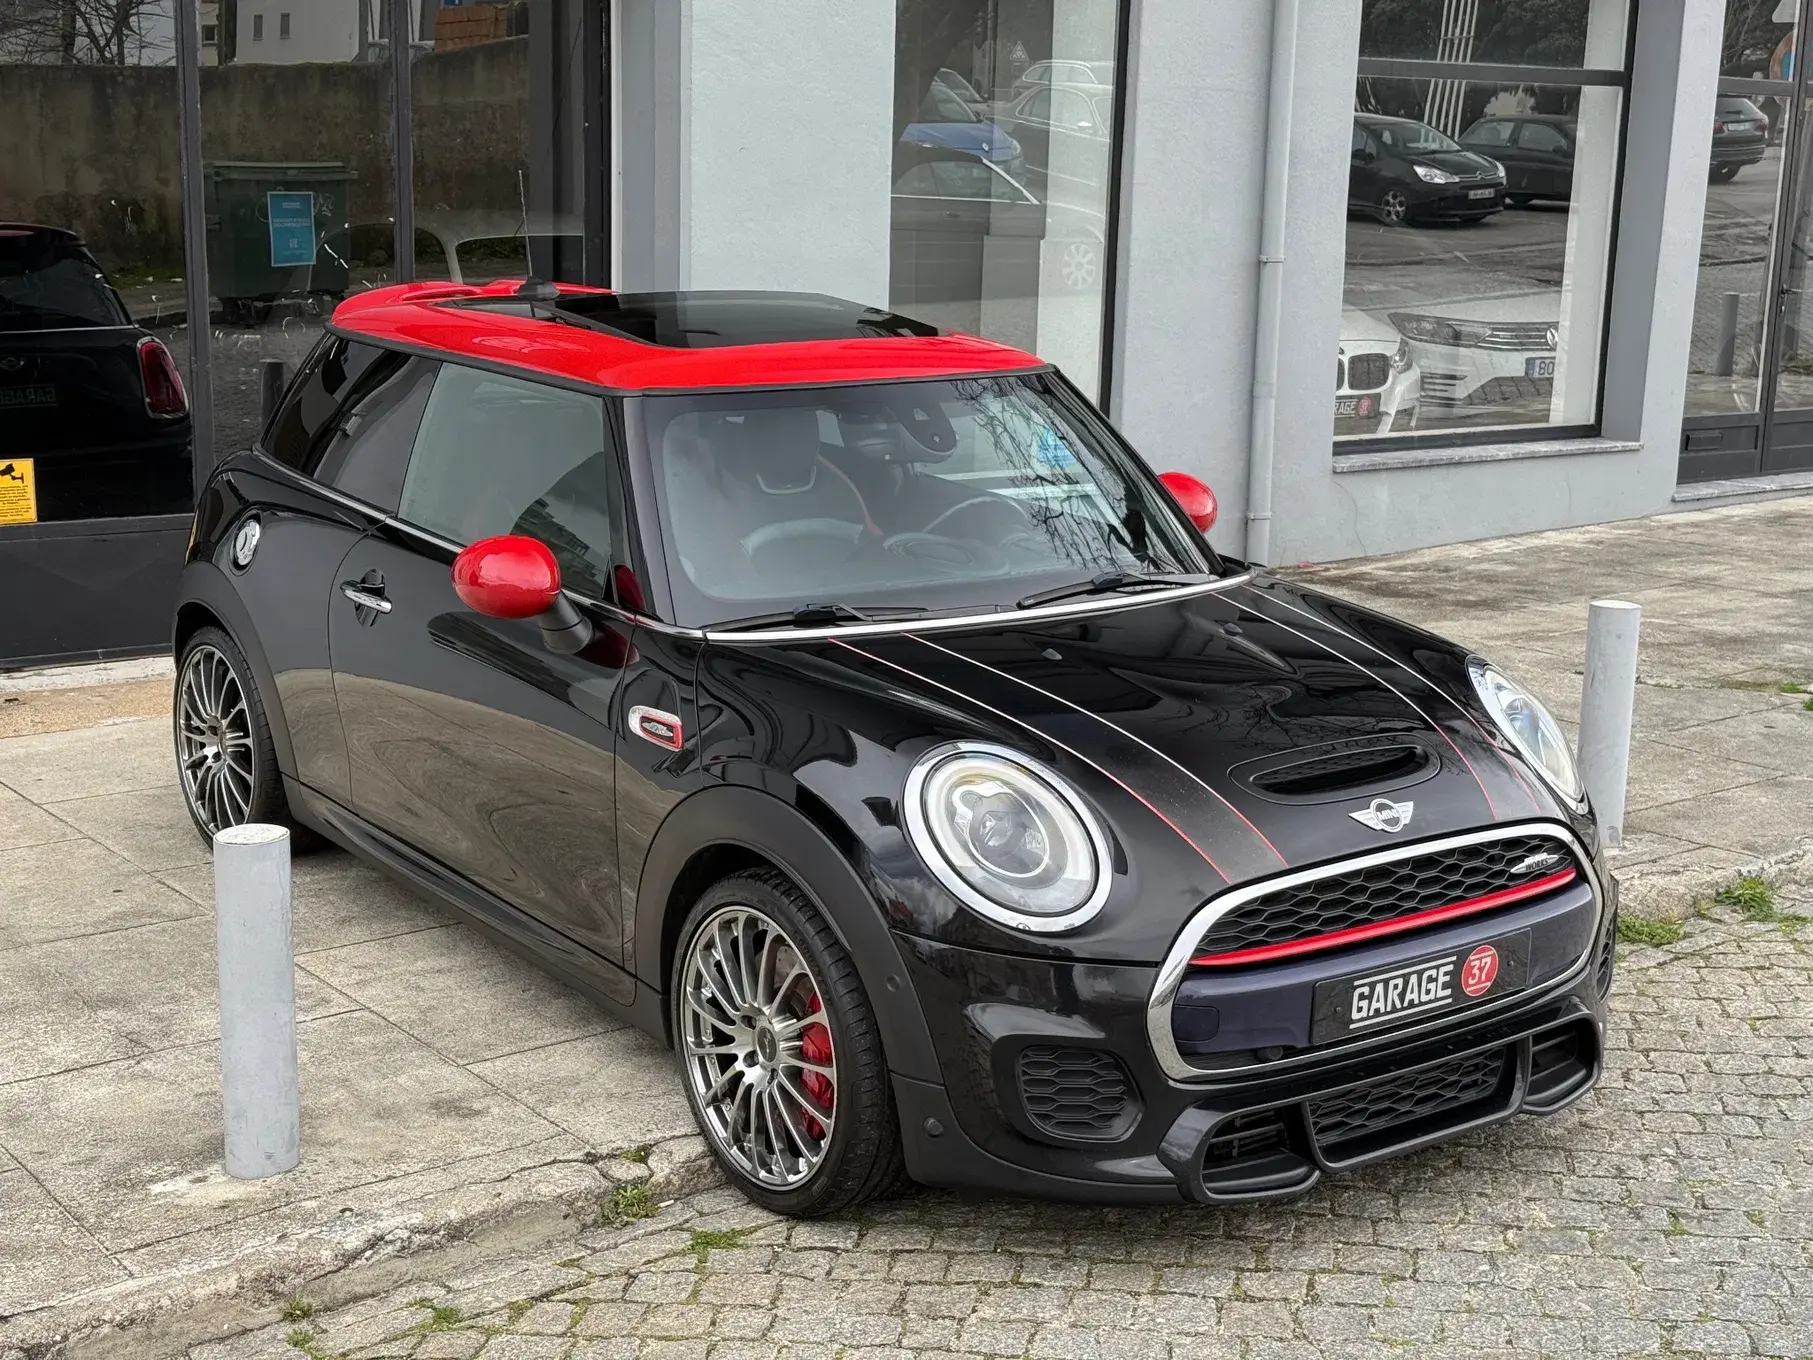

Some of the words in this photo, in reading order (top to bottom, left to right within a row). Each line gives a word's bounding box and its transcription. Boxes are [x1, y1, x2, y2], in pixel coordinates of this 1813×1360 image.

[1376, 808, 1400, 821] MINI
[1525, 857, 1549, 871] WORKS
[1351, 963, 1454, 1021] GARAGE
[1468, 956, 1492, 985] 37
